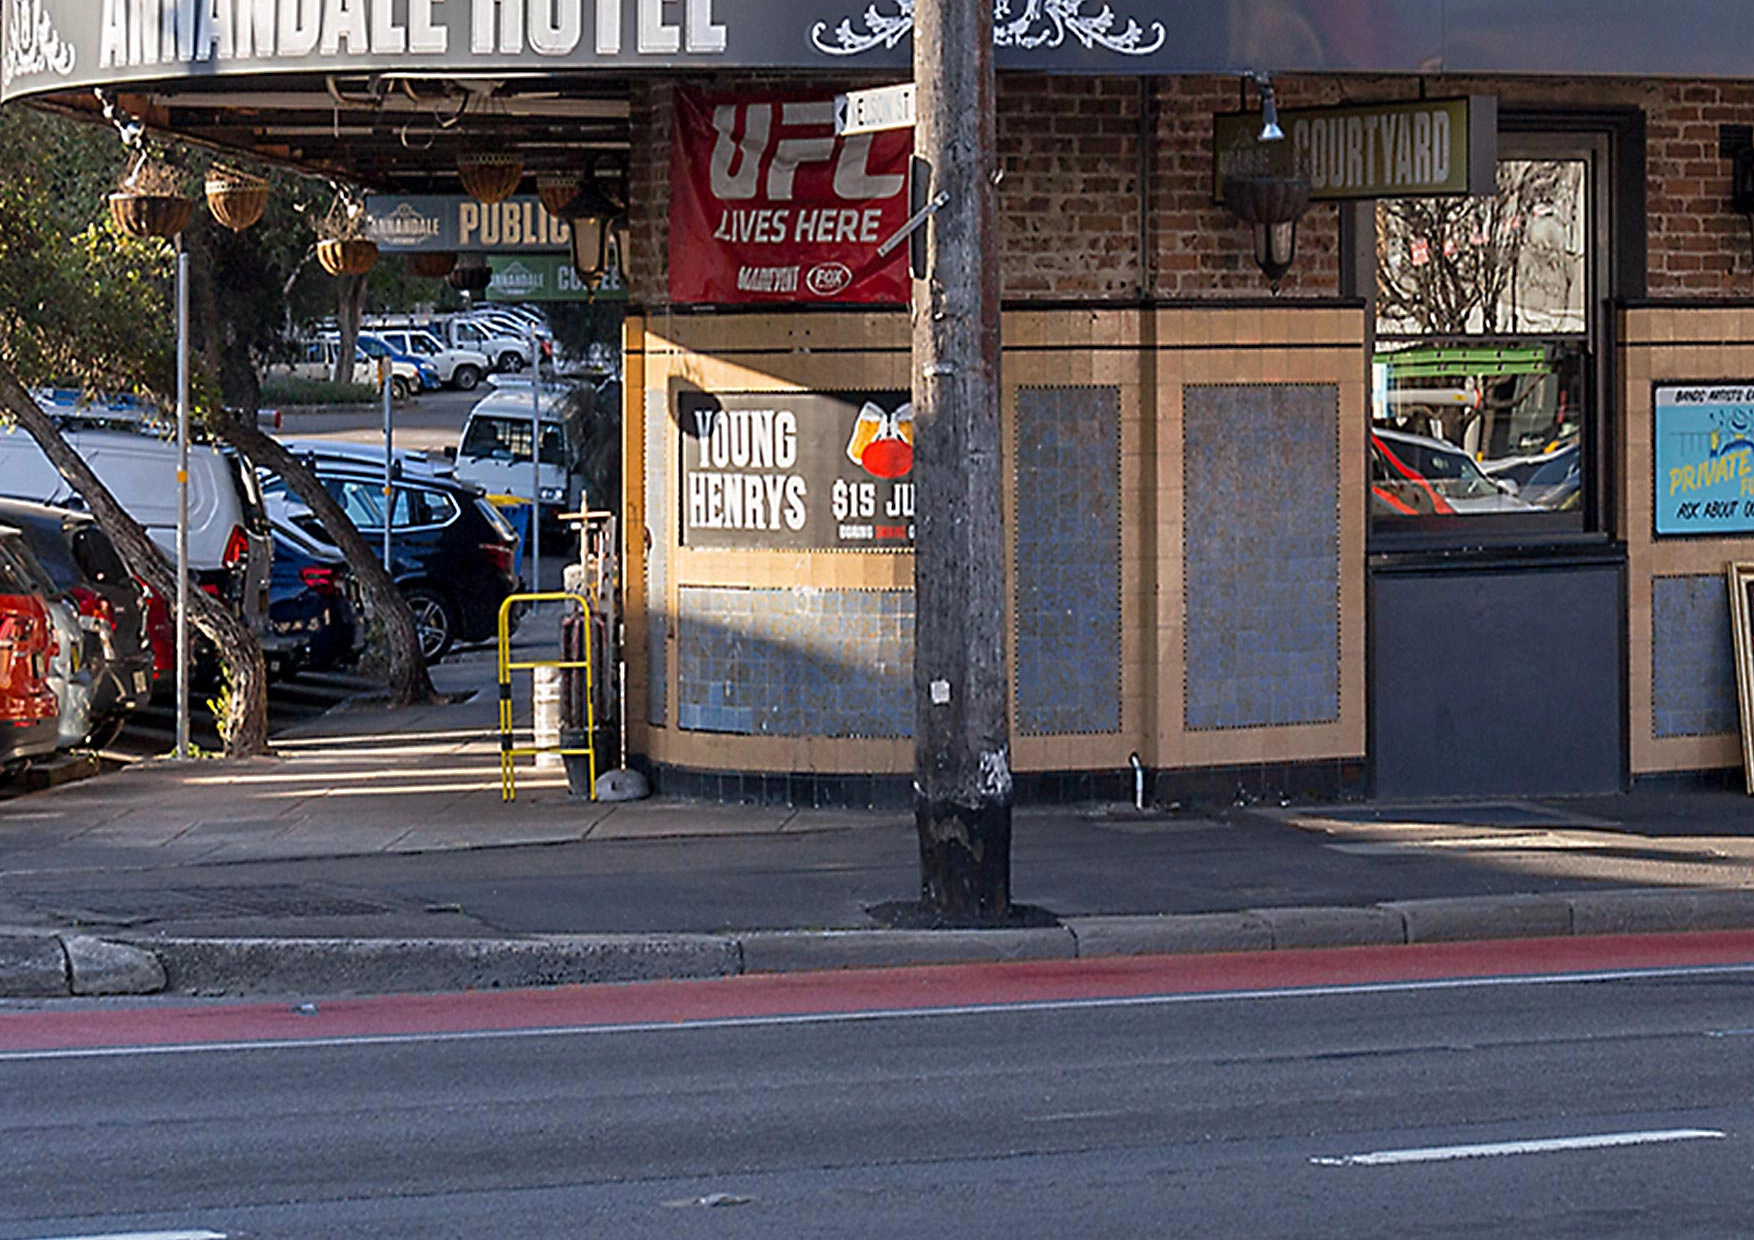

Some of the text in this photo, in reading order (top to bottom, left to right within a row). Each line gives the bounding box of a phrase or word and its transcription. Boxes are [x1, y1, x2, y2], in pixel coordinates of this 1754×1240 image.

[709, 103, 906, 200] UFC
[1293, 110, 1450, 190] COURTYARD
[459, 202, 571, 246] PUBLIC
[713, 208, 883, 243] LIVES HERE
[556, 265, 621, 291] COEE
[694, 409, 798, 470] YOUNG
[1668, 450, 1752, 498] PRIVATE
[688, 472, 807, 531] HENRYS
[831, 478, 876, 521] $15
[1676, 502, 1701, 519] ASK
[1703, 500, 1739, 519] ABOUT
